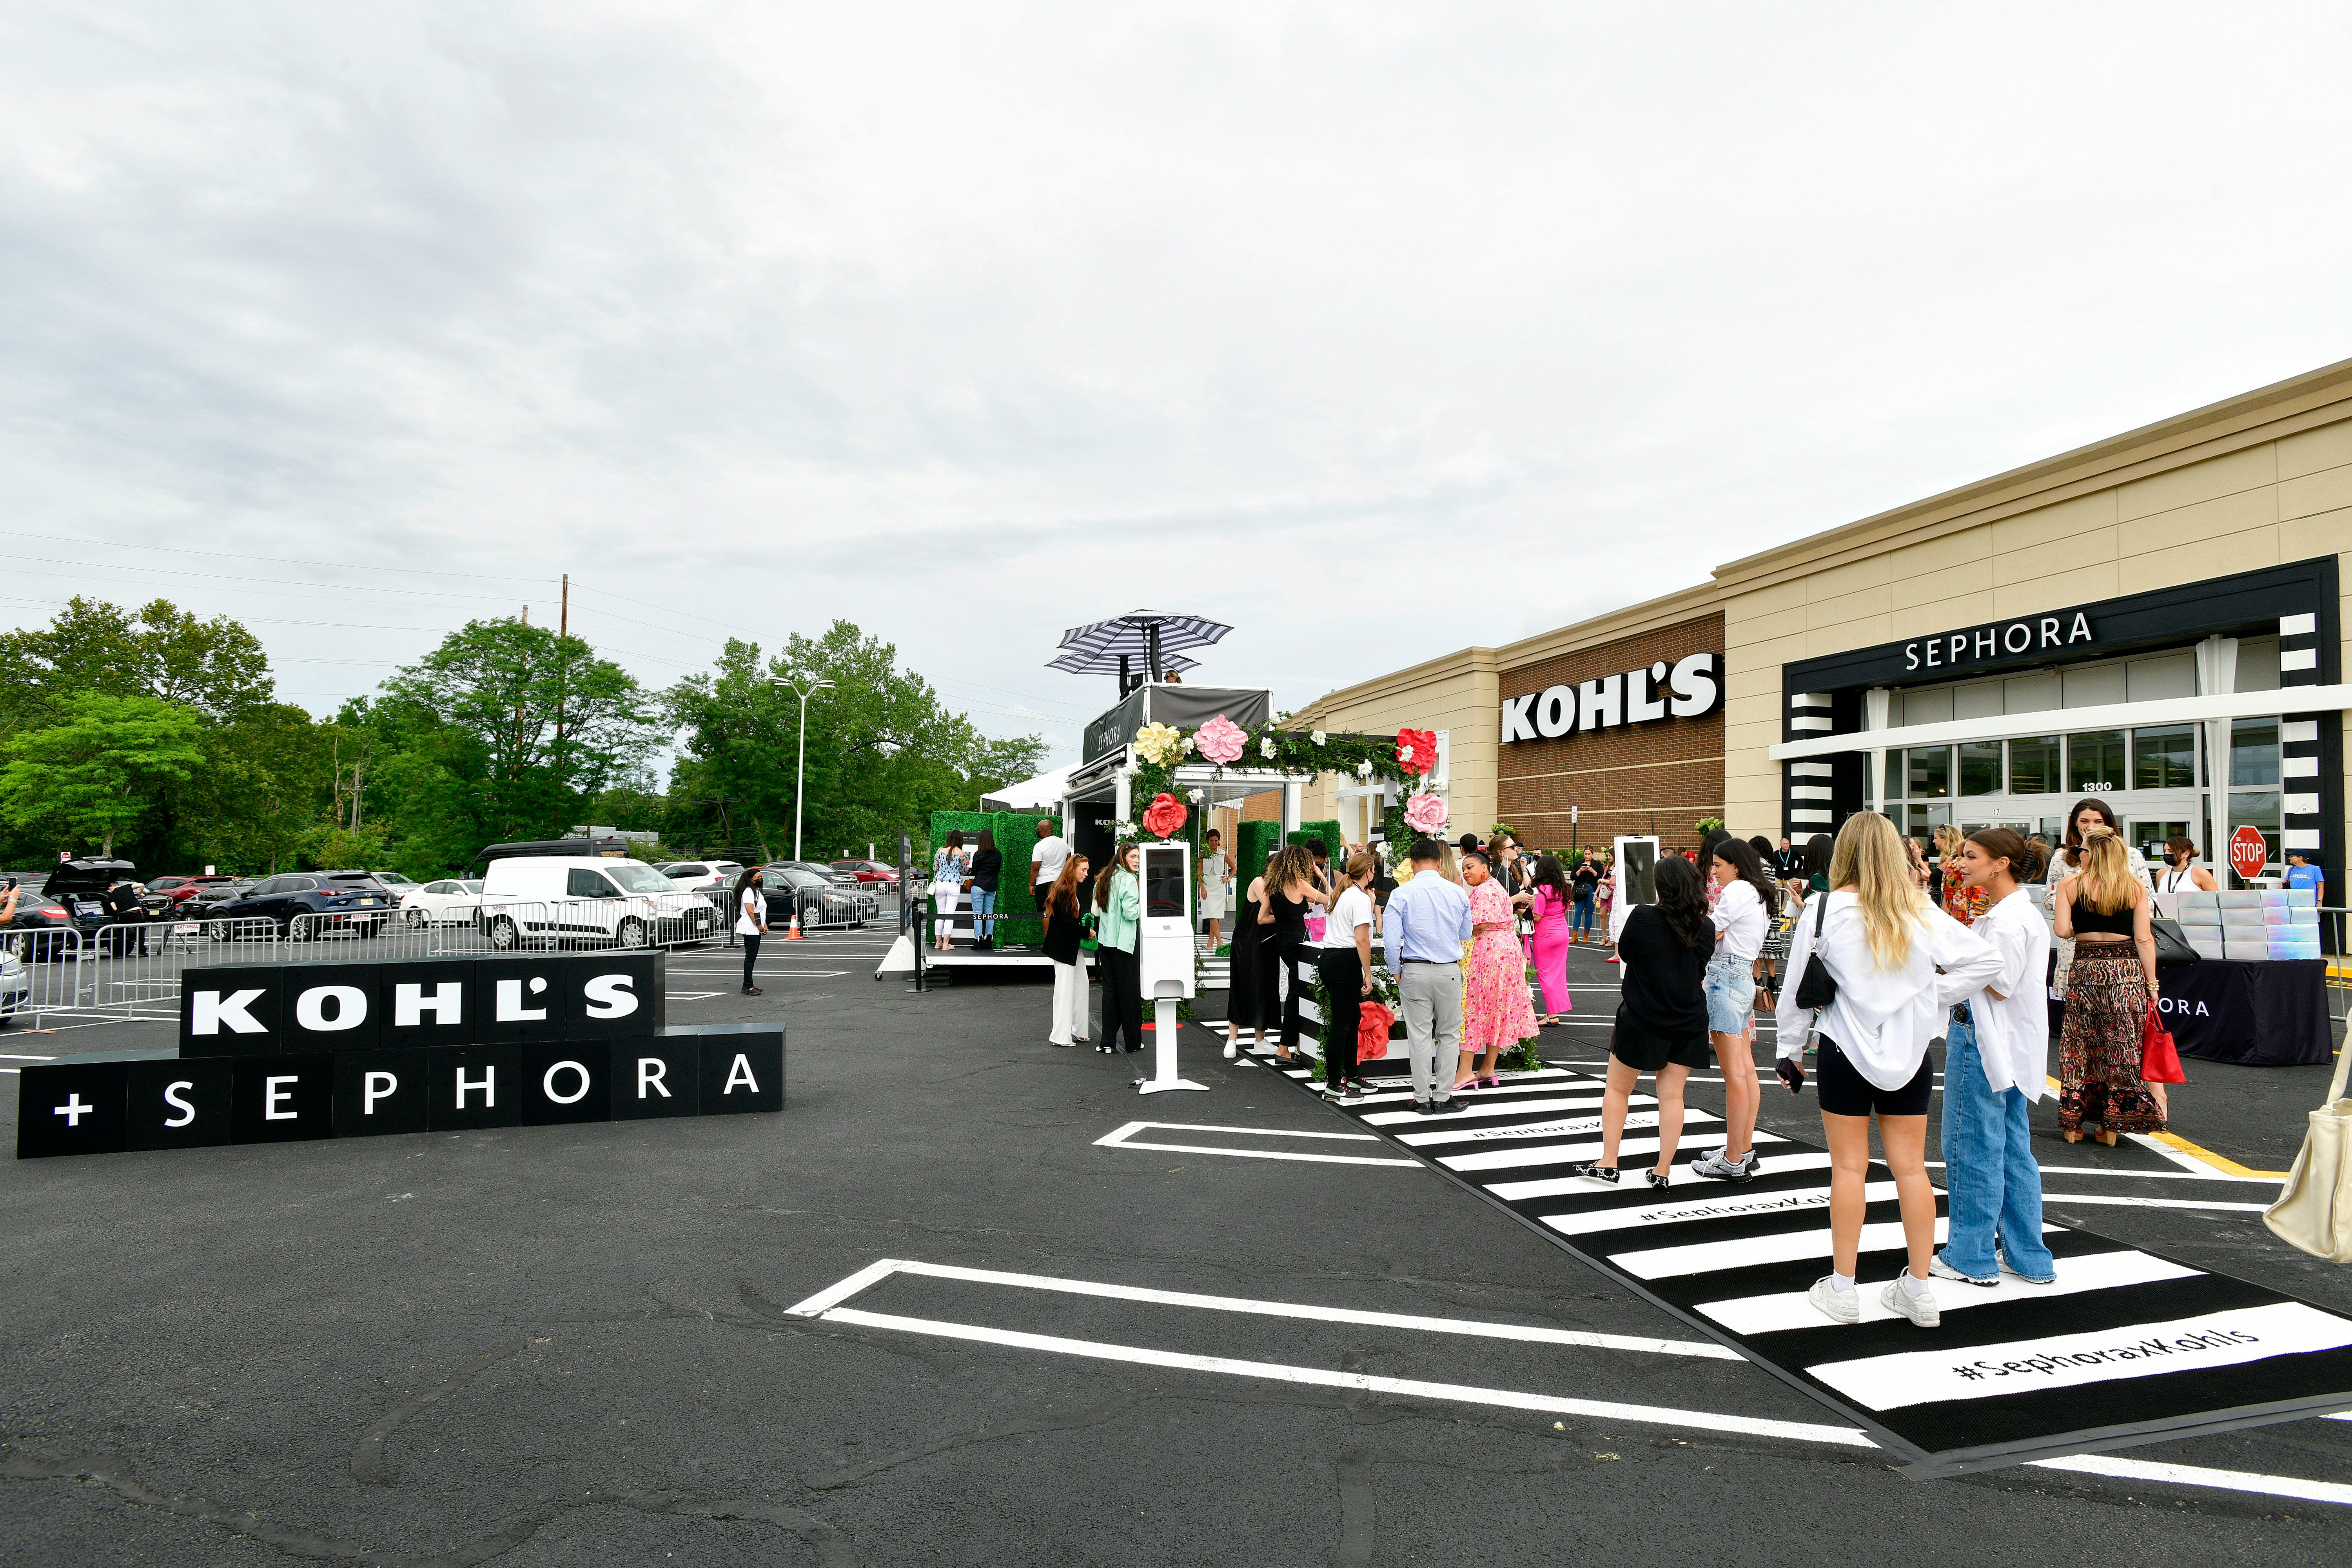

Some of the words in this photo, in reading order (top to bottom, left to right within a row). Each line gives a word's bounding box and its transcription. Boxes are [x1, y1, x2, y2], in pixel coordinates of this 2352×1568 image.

[1906, 612, 2092, 670] SEPHORA
[1501, 653, 1716, 743] KOHL'S
[1098, 724, 1120, 751] SEPHORA
[2082, 782, 2112, 791] 1300
[2233, 842, 2263, 862] STOP
[192, 974, 639, 1035] KOHL'S
[164, 1053, 760, 1127] SEPHORA
[1952, 1330, 2259, 1380] #SephoraxKohls
